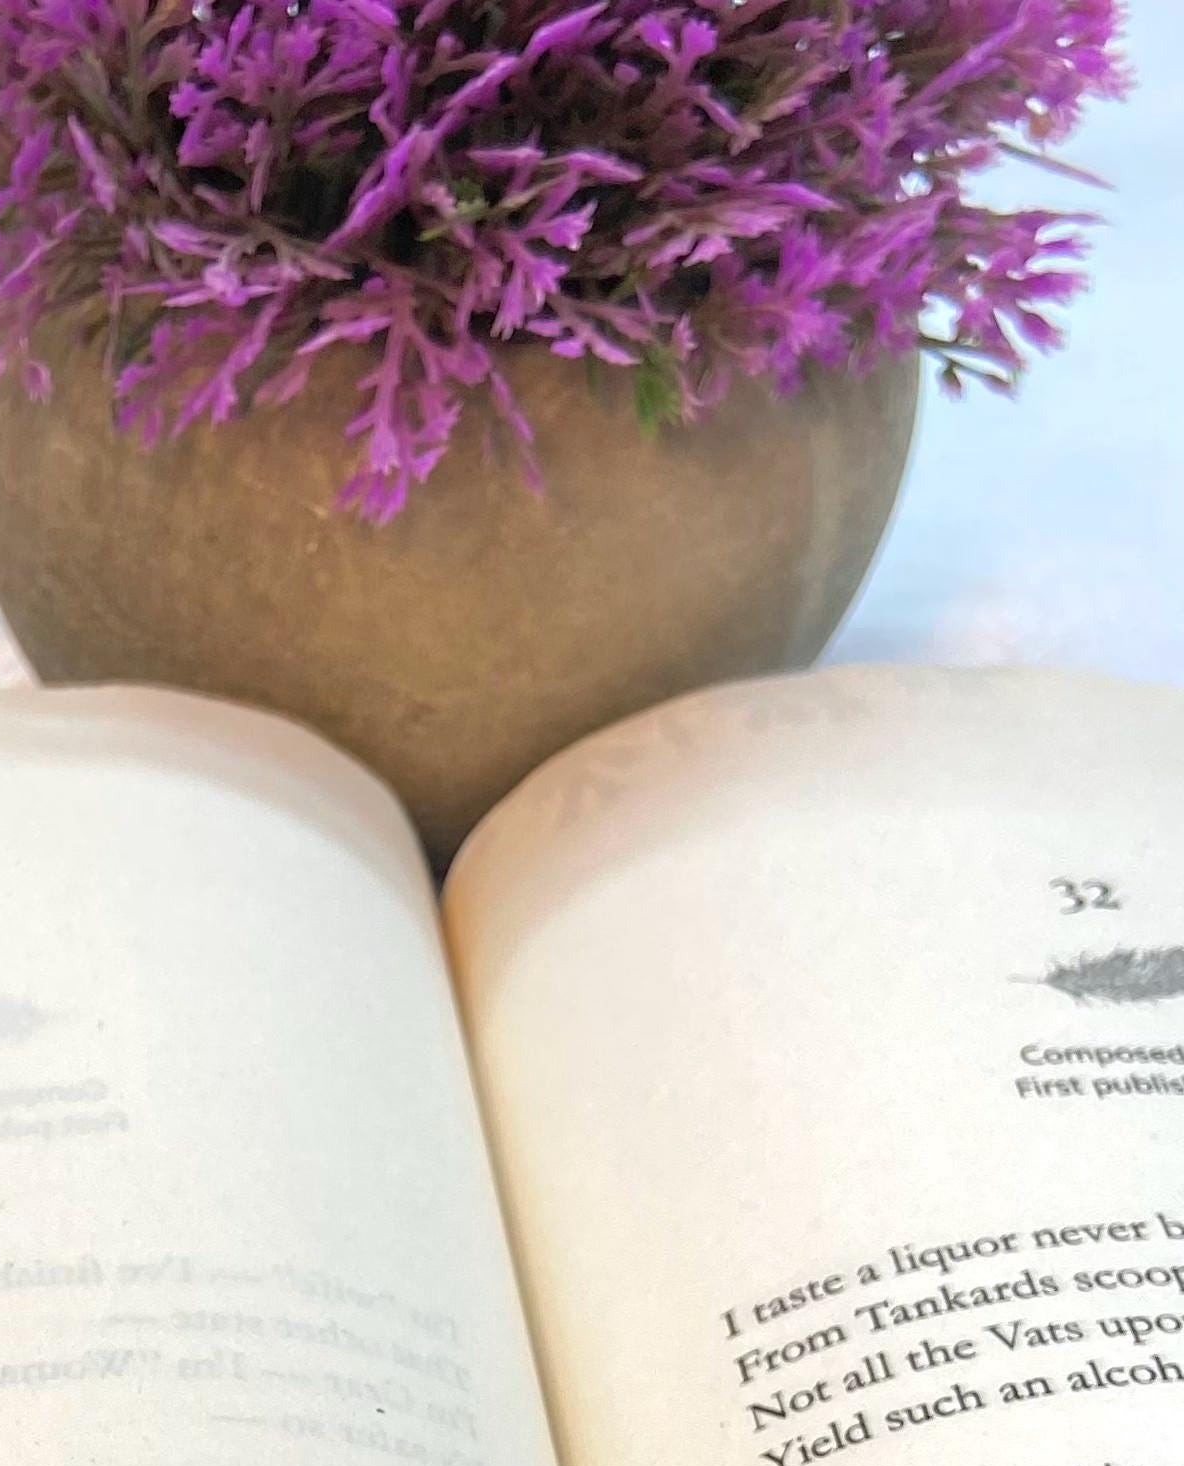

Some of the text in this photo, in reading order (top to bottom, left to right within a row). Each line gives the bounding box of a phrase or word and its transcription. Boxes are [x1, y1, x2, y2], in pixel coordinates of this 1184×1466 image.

[1048, 877, 1122, 915] 32
[1020, 1042, 1184, 1068] Composed
[1016, 1072, 1184, 1100] First publis
[721, 1308, 742, 1340] I
[752, 1273, 847, 1325] taste
[856, 1263, 881, 1286] a
[889, 1231, 1019, 1275] liquor
[1031, 1220, 1151, 1250] never
[734, 1323, 848, 1386] From
[853, 1268, 1060, 1333] Tankards
[746, 1313, 1184, 1433] Not all the Vats upo
[884, 1383, 987, 1432] such
[998, 1376, 1057, 1404] an
